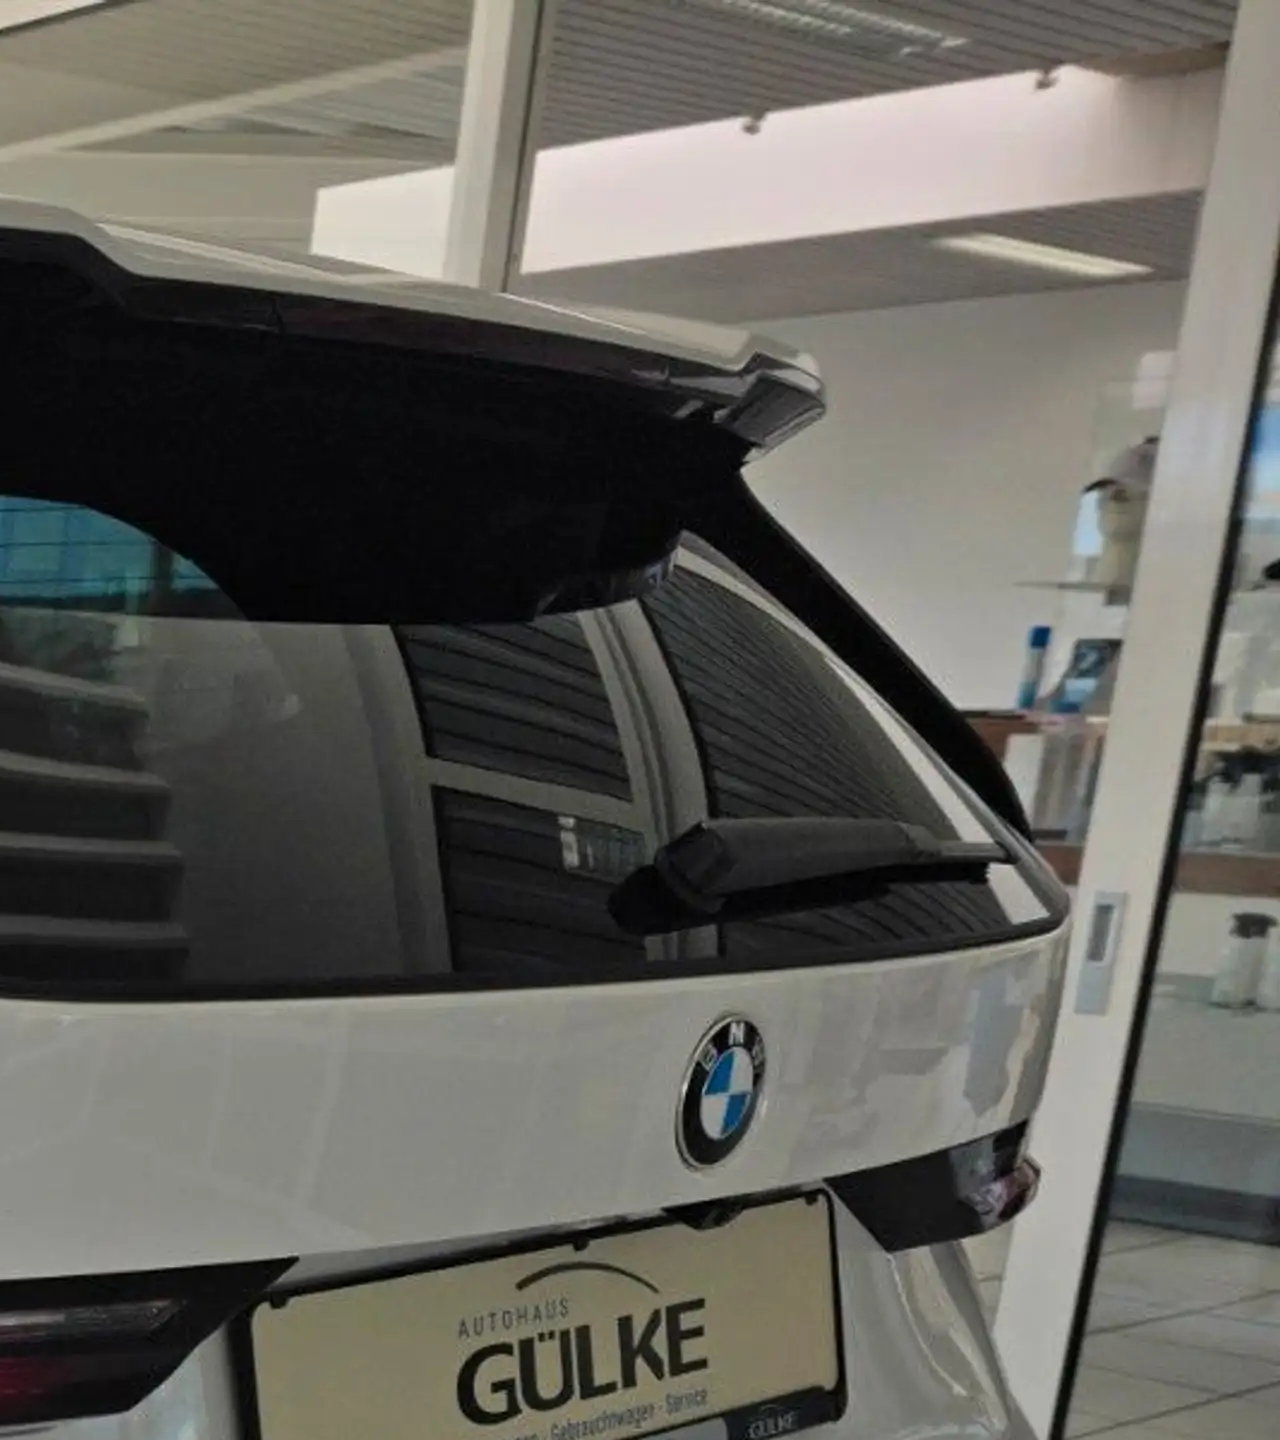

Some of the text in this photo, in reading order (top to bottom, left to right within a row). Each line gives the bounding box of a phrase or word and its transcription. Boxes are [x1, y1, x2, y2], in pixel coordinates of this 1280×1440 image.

[458, 1298, 570, 1340] AUTOHAUS
[456, 1298, 708, 1426] GÜLKE
[665, 1388, 709, 1415] Service
